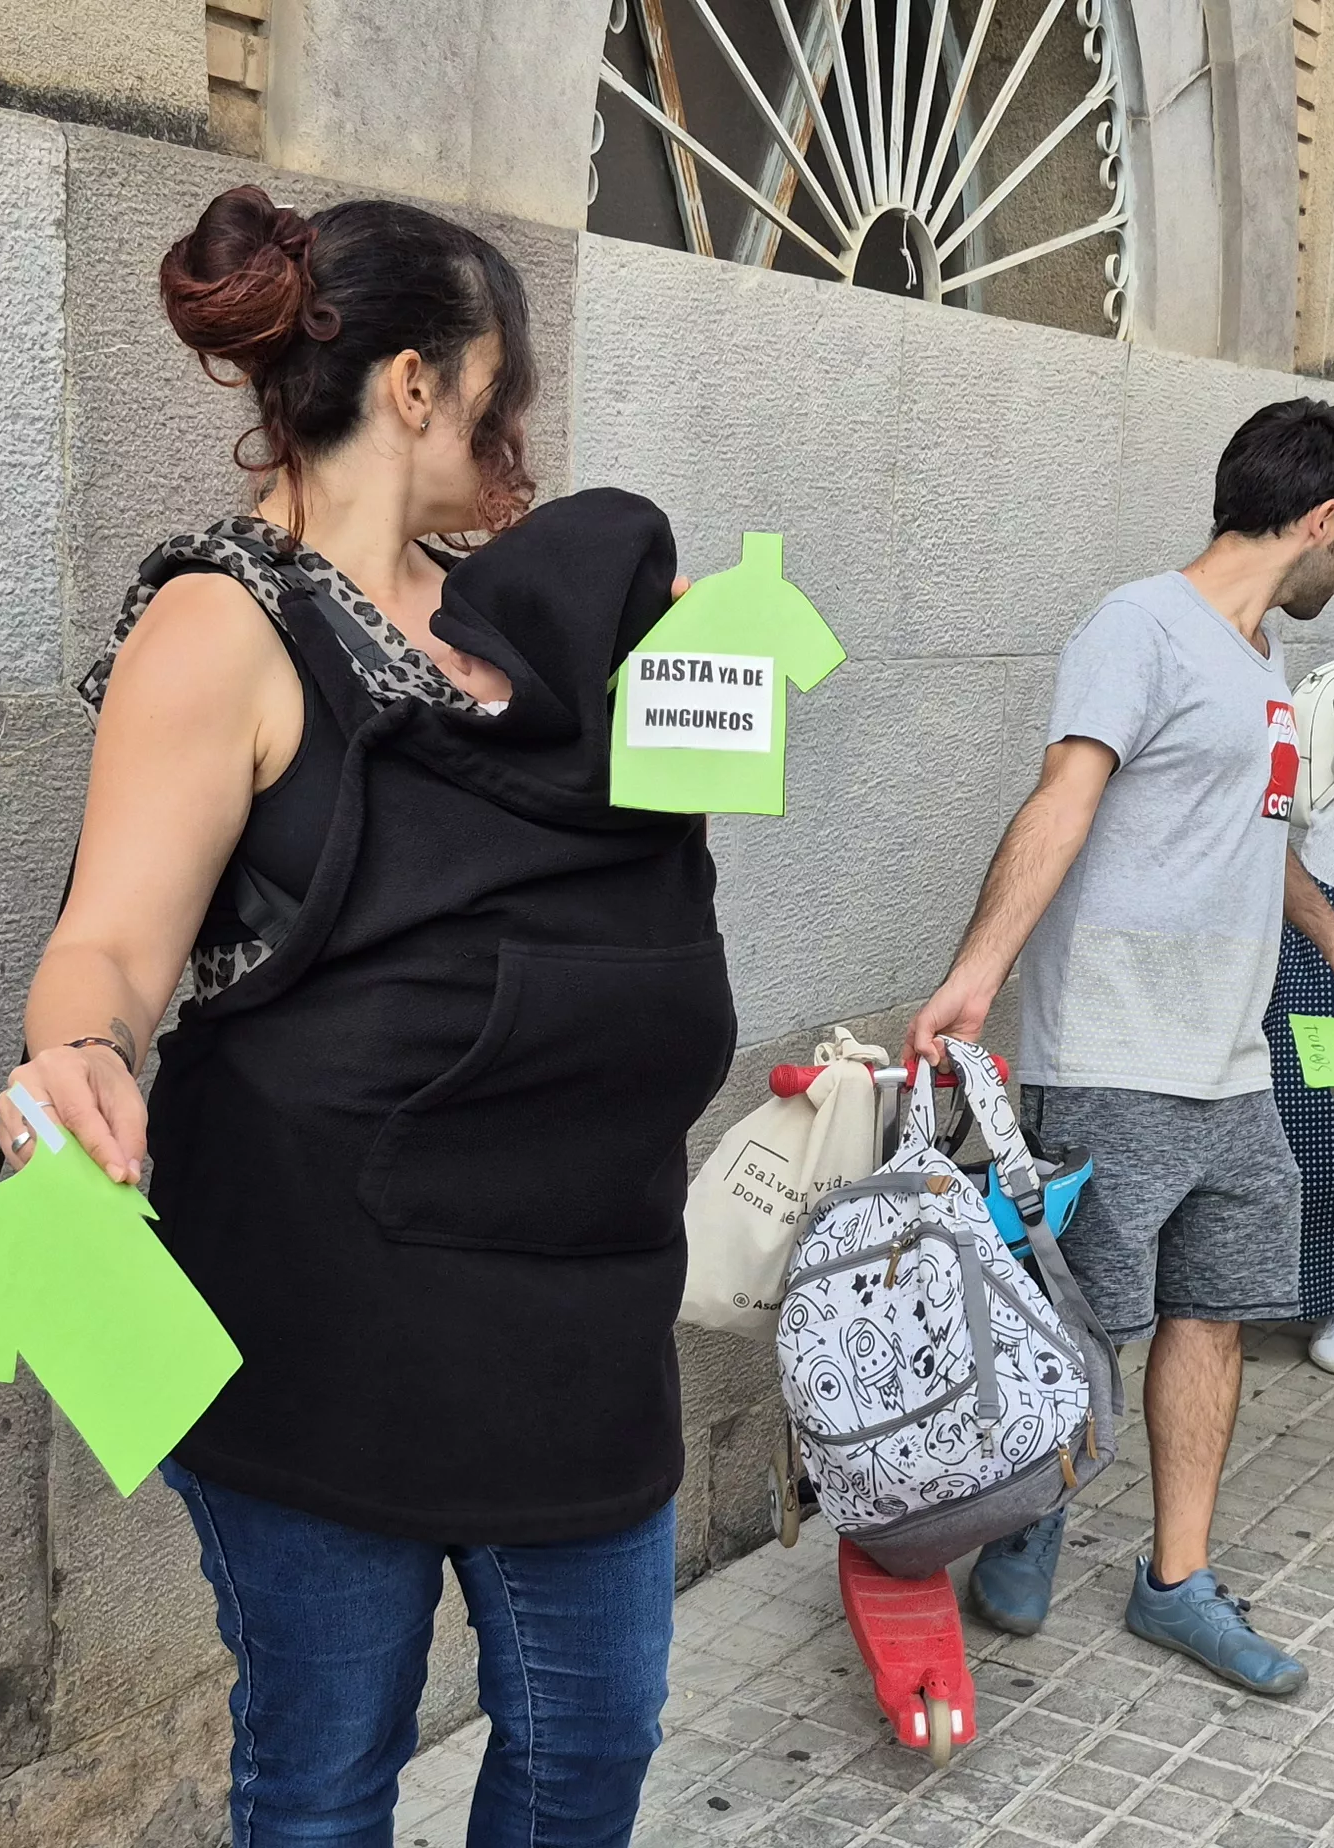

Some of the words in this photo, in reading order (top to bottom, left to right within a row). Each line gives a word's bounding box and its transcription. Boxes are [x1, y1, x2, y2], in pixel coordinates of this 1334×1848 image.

[640, 658, 714, 683] BASTA
[718, 666, 738, 685] YA
[743, 668, 764, 687] DE
[645, 707, 754, 731] NINGUNEOS
[1267, 793, 1293, 818] CGT
[731, 1182, 775, 1216] Dona
